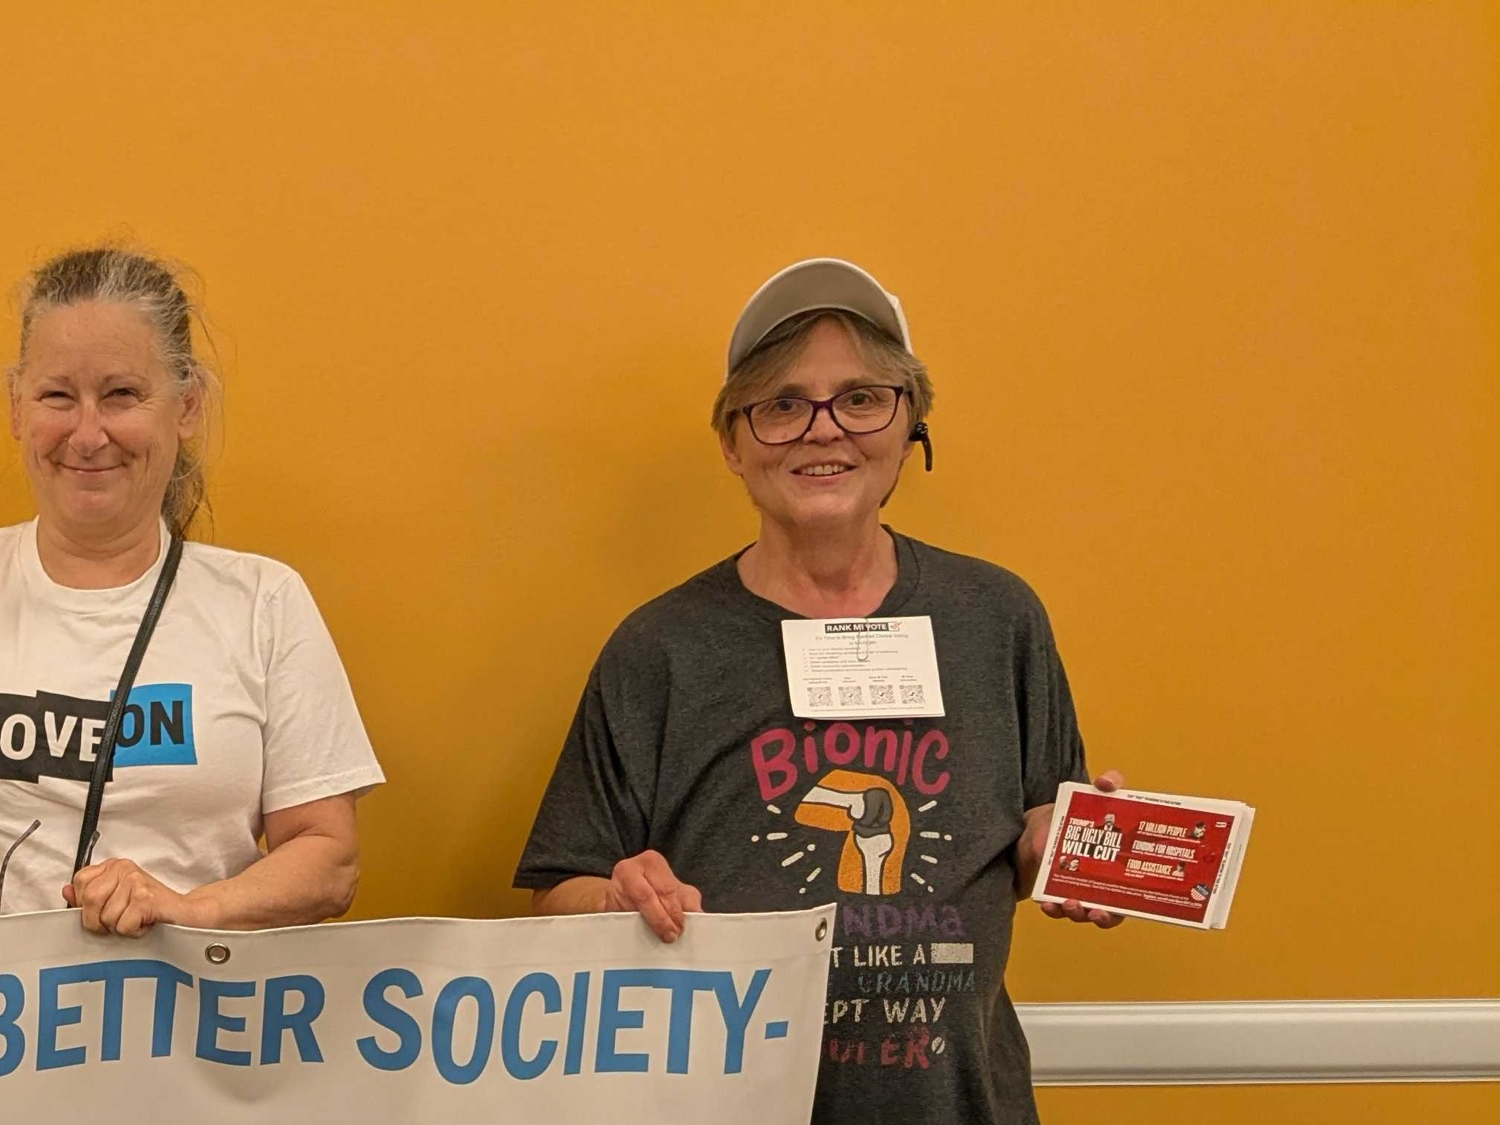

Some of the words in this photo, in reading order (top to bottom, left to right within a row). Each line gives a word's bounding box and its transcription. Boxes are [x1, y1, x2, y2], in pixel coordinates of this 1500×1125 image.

[826, 624, 852, 632] RANK
[865, 623, 887, 631] VOTE
[1064, 824, 1082, 841] BIG
[1081, 827, 1104, 845] UGLY
[1103, 830, 1122, 848] BILL
[1061, 839, 1091, 858] WILL
[1093, 845, 1120, 862] CUT
[854, 945, 902, 968] LIKE
[913, 943, 926, 965] A
[883, 996, 946, 1023] WAY
[356, 968, 789, 1085] SOCIETY-
